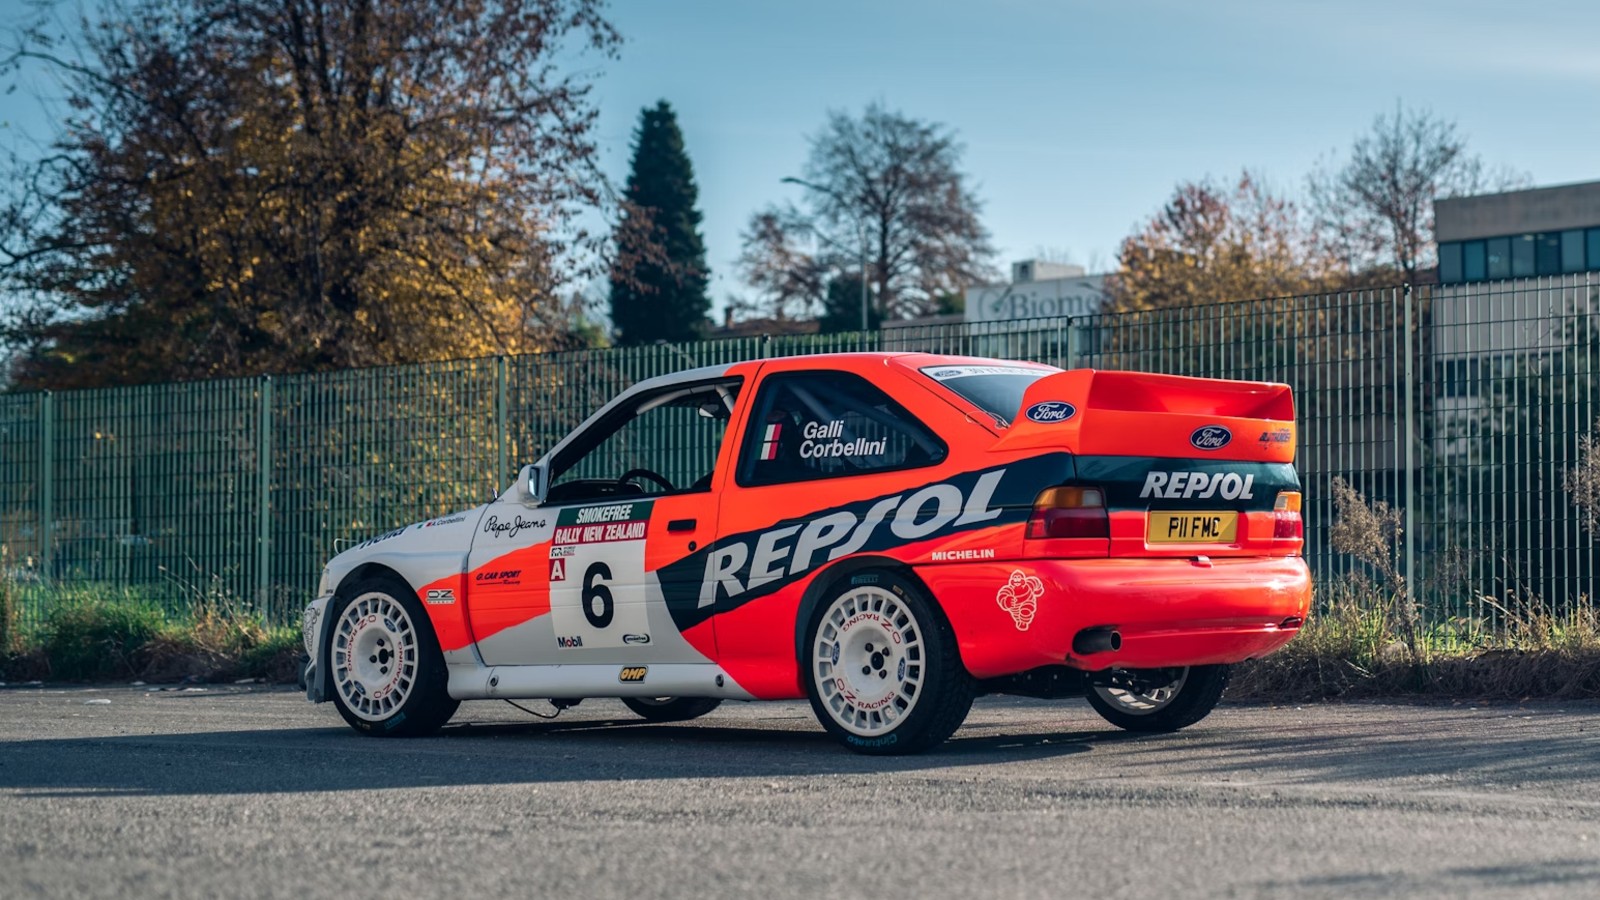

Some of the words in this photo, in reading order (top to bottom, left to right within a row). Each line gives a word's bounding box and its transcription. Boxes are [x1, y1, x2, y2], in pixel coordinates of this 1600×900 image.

[1034, 402, 1068, 420] Ford
[803, 420, 845, 439] Galli
[1196, 428, 1226, 446] Ford
[800, 437, 887, 459] Corbellini
[1139, 471, 1254, 500] REPSOL
[576, 504, 633, 524] SMOKEFREE
[484, 515, 512, 538] Pepe
[509, 515, 546, 538] Jeans
[555, 527, 582, 544] RALLY
[583, 525, 605, 542] NEW
[605, 522, 645, 541] ZEALAND
[1191, 517, 1221, 538] FMC
[697, 468, 1007, 609] REPSOL
[931, 549, 995, 560] MICHELIN
[551, 560, 564, 580] A
[582, 562, 614, 628] 6
[557, 636, 583, 648] Mobil
[620, 668, 646, 680] OMP
[857, 691, 895, 709] RACING
